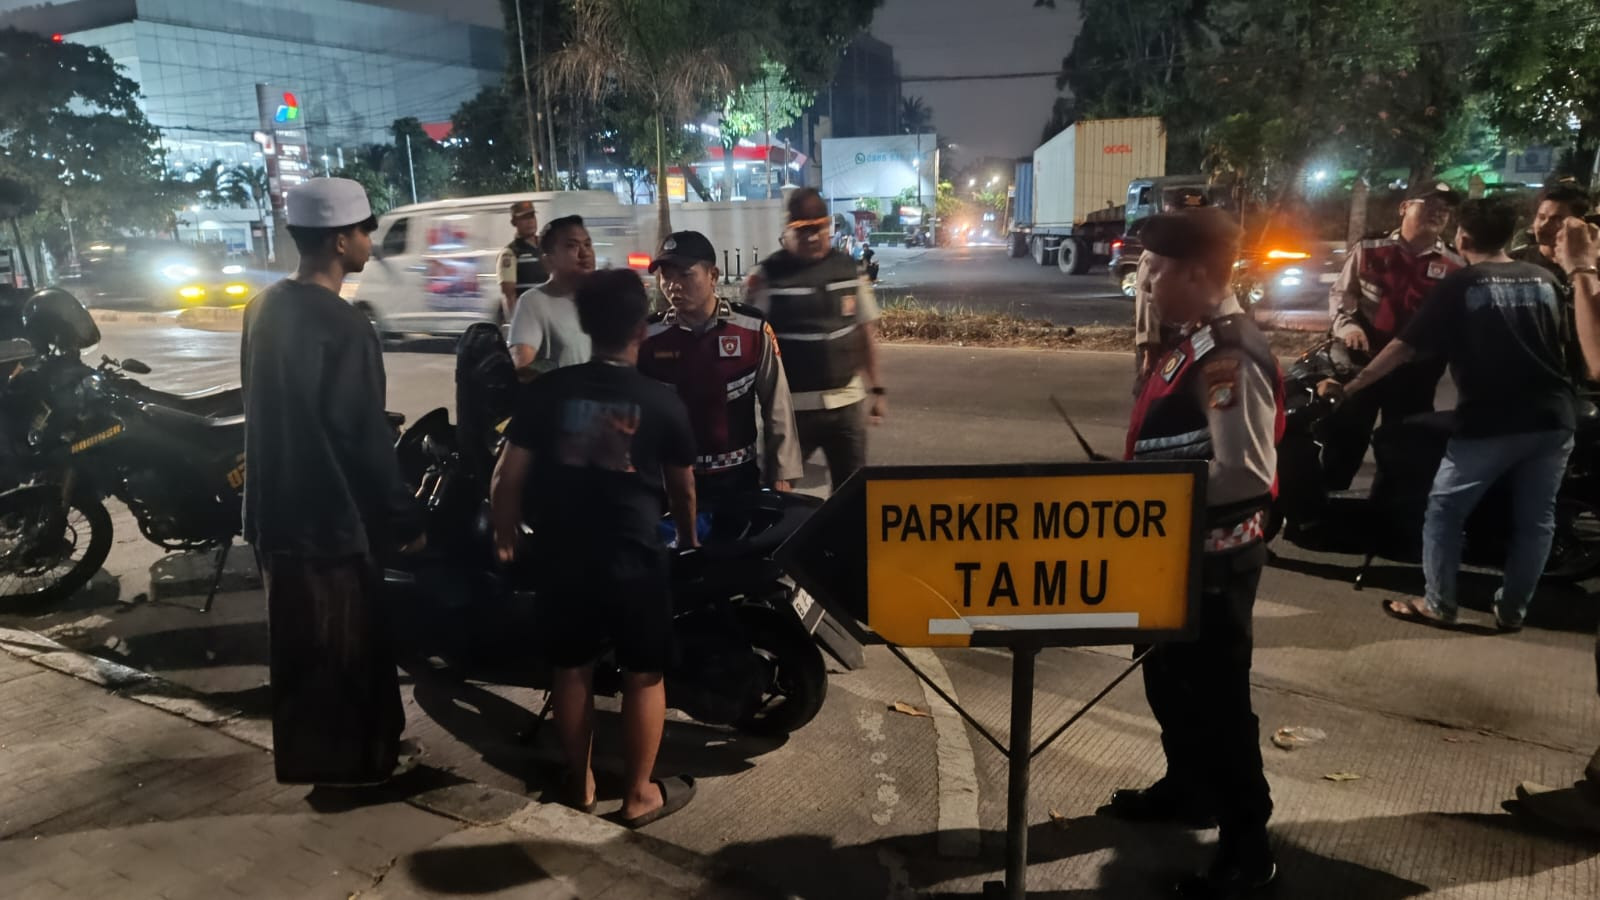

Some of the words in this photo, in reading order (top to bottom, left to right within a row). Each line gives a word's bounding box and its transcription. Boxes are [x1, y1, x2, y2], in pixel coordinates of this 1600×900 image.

[881, 503, 1019, 541] PARKIR
[1033, 500, 1167, 540] MOTOR
[954, 560, 1108, 607] TAMU
